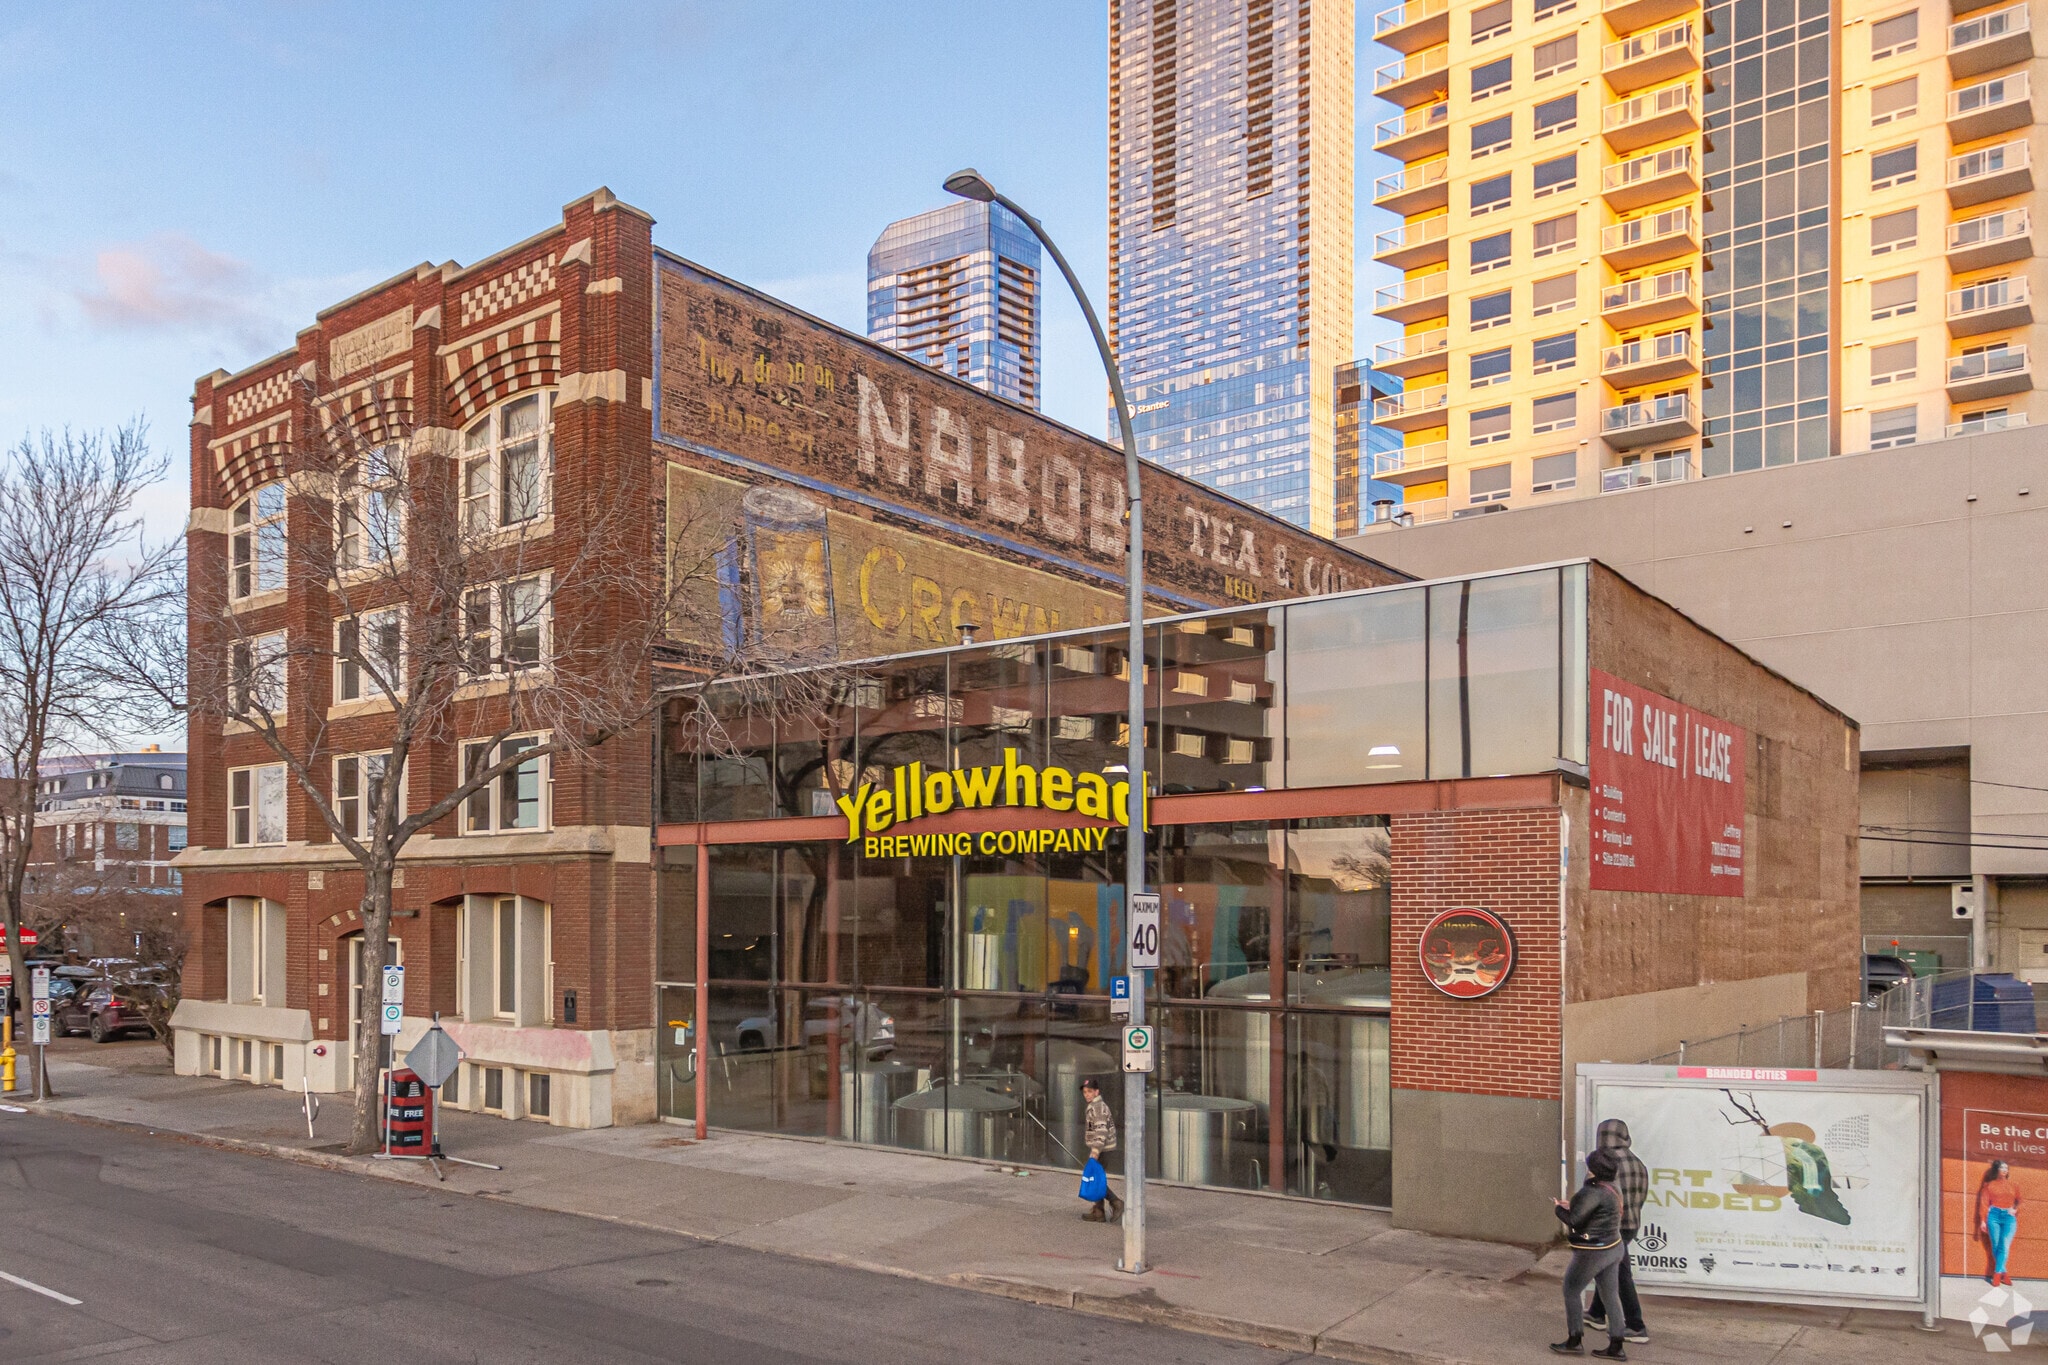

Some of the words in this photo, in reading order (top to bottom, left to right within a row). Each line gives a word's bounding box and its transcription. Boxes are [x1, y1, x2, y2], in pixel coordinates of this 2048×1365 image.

[1137, 400, 1170, 414] Stantec
[857, 374, 1126, 557] NABOB
[1184, 506, 1261, 577] TEA
[1603, 688, 1633, 756] FOR
[1643, 704, 1677, 769] SALE
[1695, 723, 1731, 784] LEASE
[836, 747, 1148, 845] Yellowhead
[865, 832, 972, 859] BREWING
[980, 826, 1109, 856] COMPANY
[1133, 901, 1159, 913] MAXIMUM
[1133, 923, 1157, 956] 40
[1706, 1068, 1753, 1080] BRANDED
[1754, 1069, 1788, 1081] CITIES
[404, 1109, 424, 1118] FREE
[1980, 1123, 2000, 1136] Be
[2004, 1125, 2031, 1138] the
[2035, 1127, 2048, 1139] C
[1980, 1139, 2008, 1152] that
[2013, 1141, 2046, 1155] lives
[1652, 1167, 1712, 1188] RT
[1645, 1189, 1782, 1213] ANDED
[1630, 1254, 1688, 1269] EWORKS
